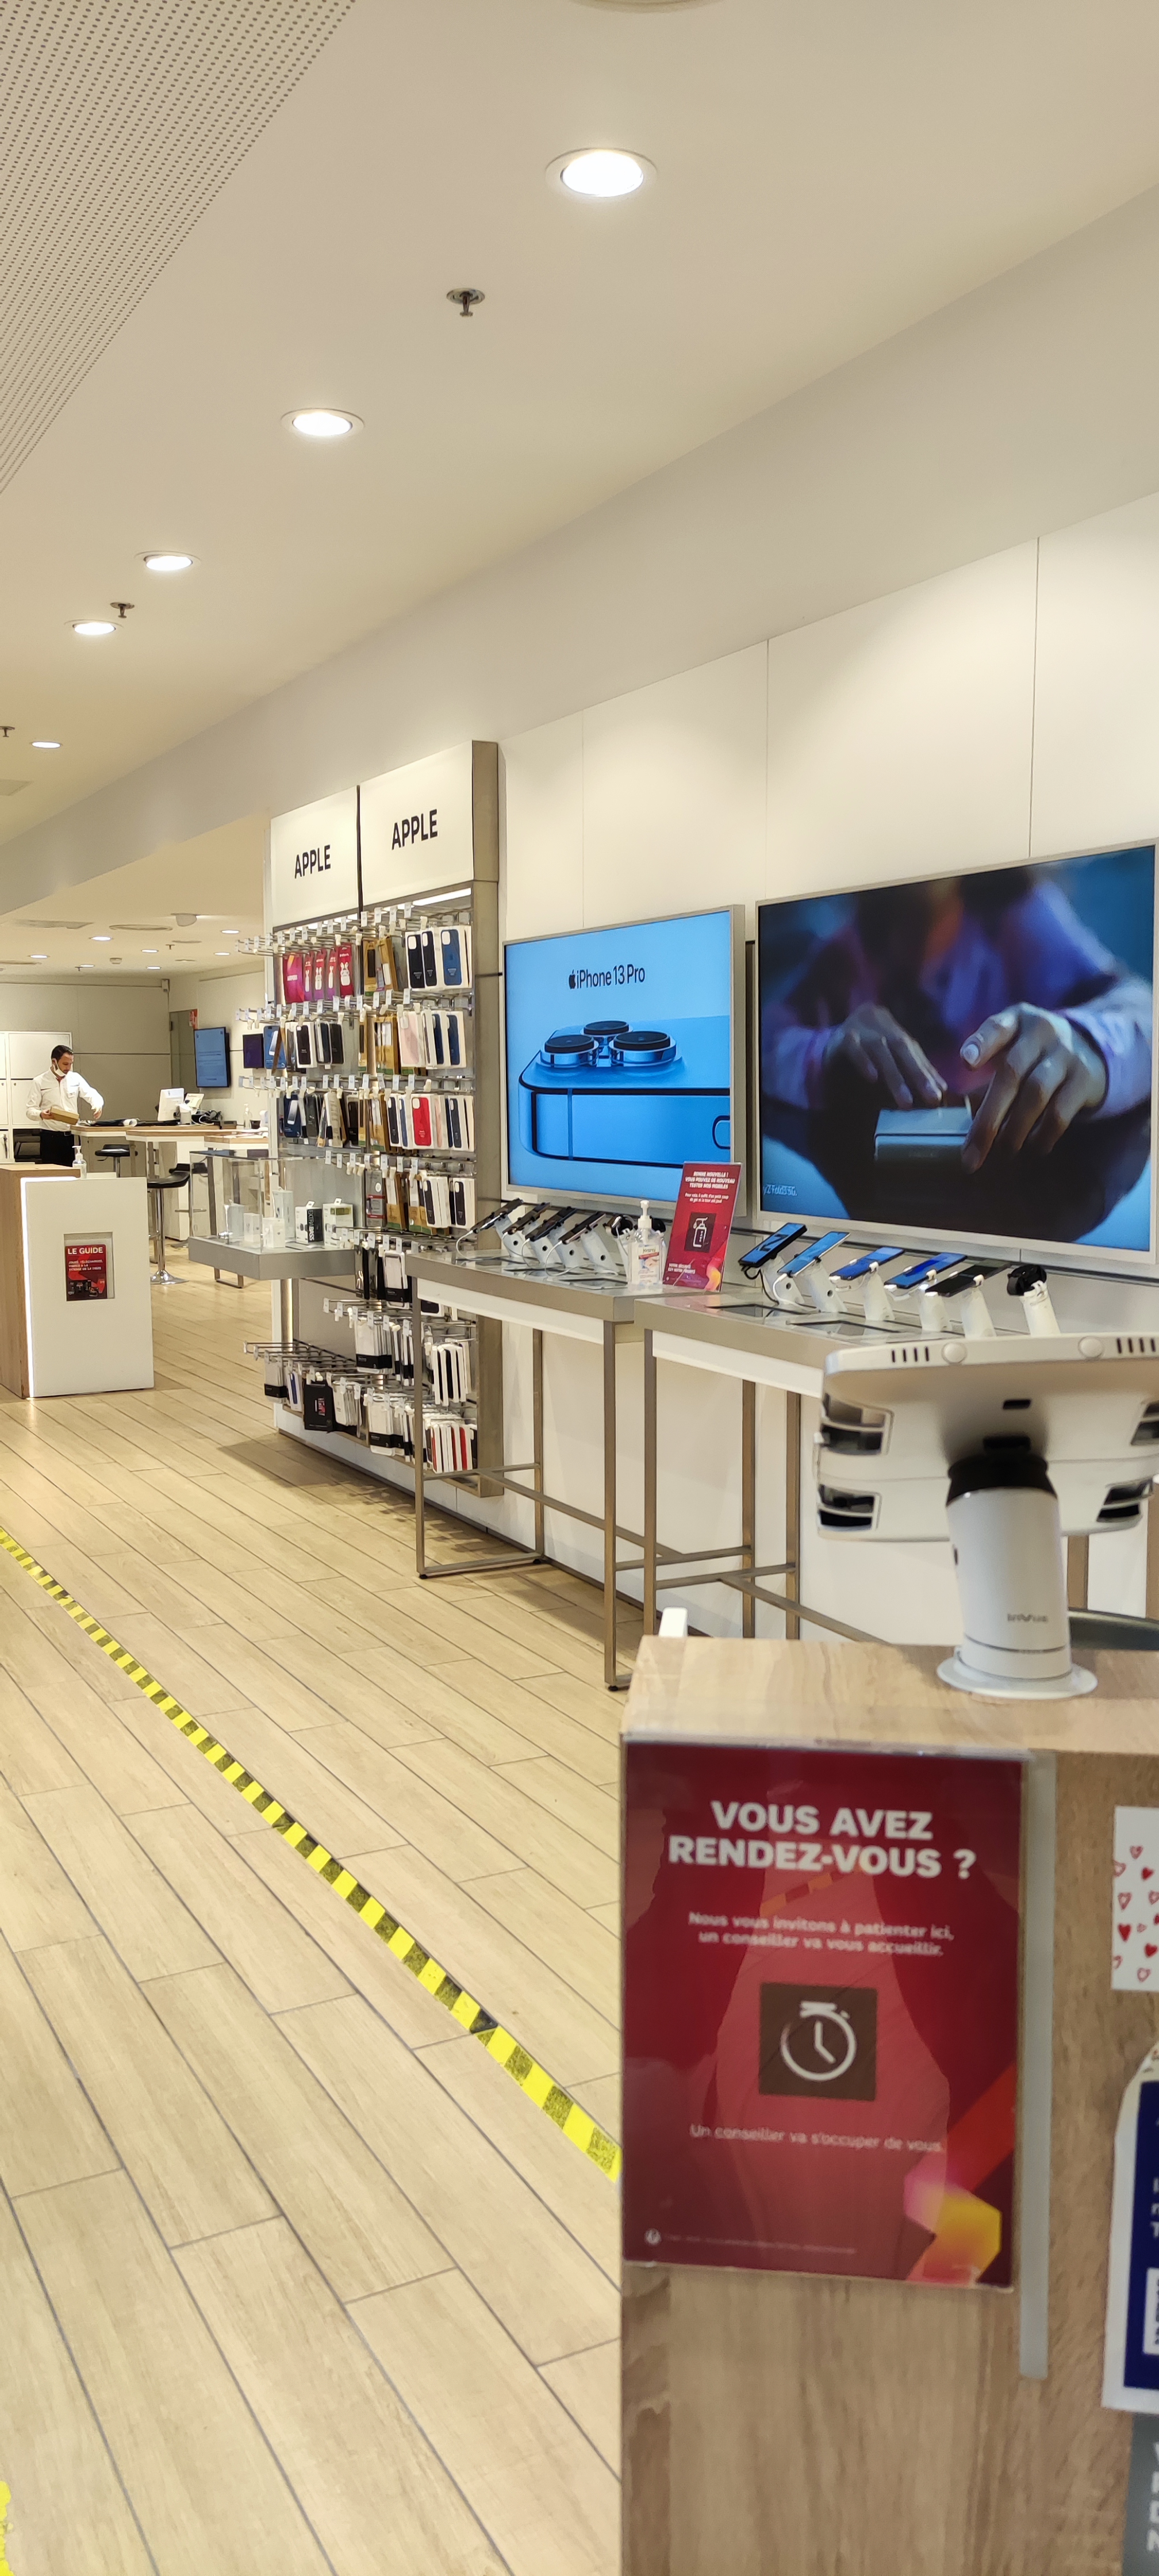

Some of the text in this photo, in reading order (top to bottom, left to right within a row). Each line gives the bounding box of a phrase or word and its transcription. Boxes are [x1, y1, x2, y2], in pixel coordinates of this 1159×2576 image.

[392, 809, 437, 850] APPLE
[294, 845, 331, 879] APPLE
[577, 964, 646, 989] iPhone 13 Pro
[711, 1801, 933, 1840] VOUS AVEZ
[668, 1834, 976, 1879] RENDEZ-VOUS ?
[689, 1912, 728, 1927] Nous
[733, 1916, 770, 1929] vous
[773, 1916, 836, 1933] invitons
[854, 1922, 926, 1937] patienter
[699, 1932, 720, 1943] un
[723, 1933, 800, 1948] conseiller
[803, 1937, 823, 1949] va
[826, 1939, 864, 1952] vous
[689, 2124, 711, 2138] Un
[715, 2128, 786, 2142] conseiller
[789, 2132, 808, 2144] va
[884, 2137, 903, 2150] de
